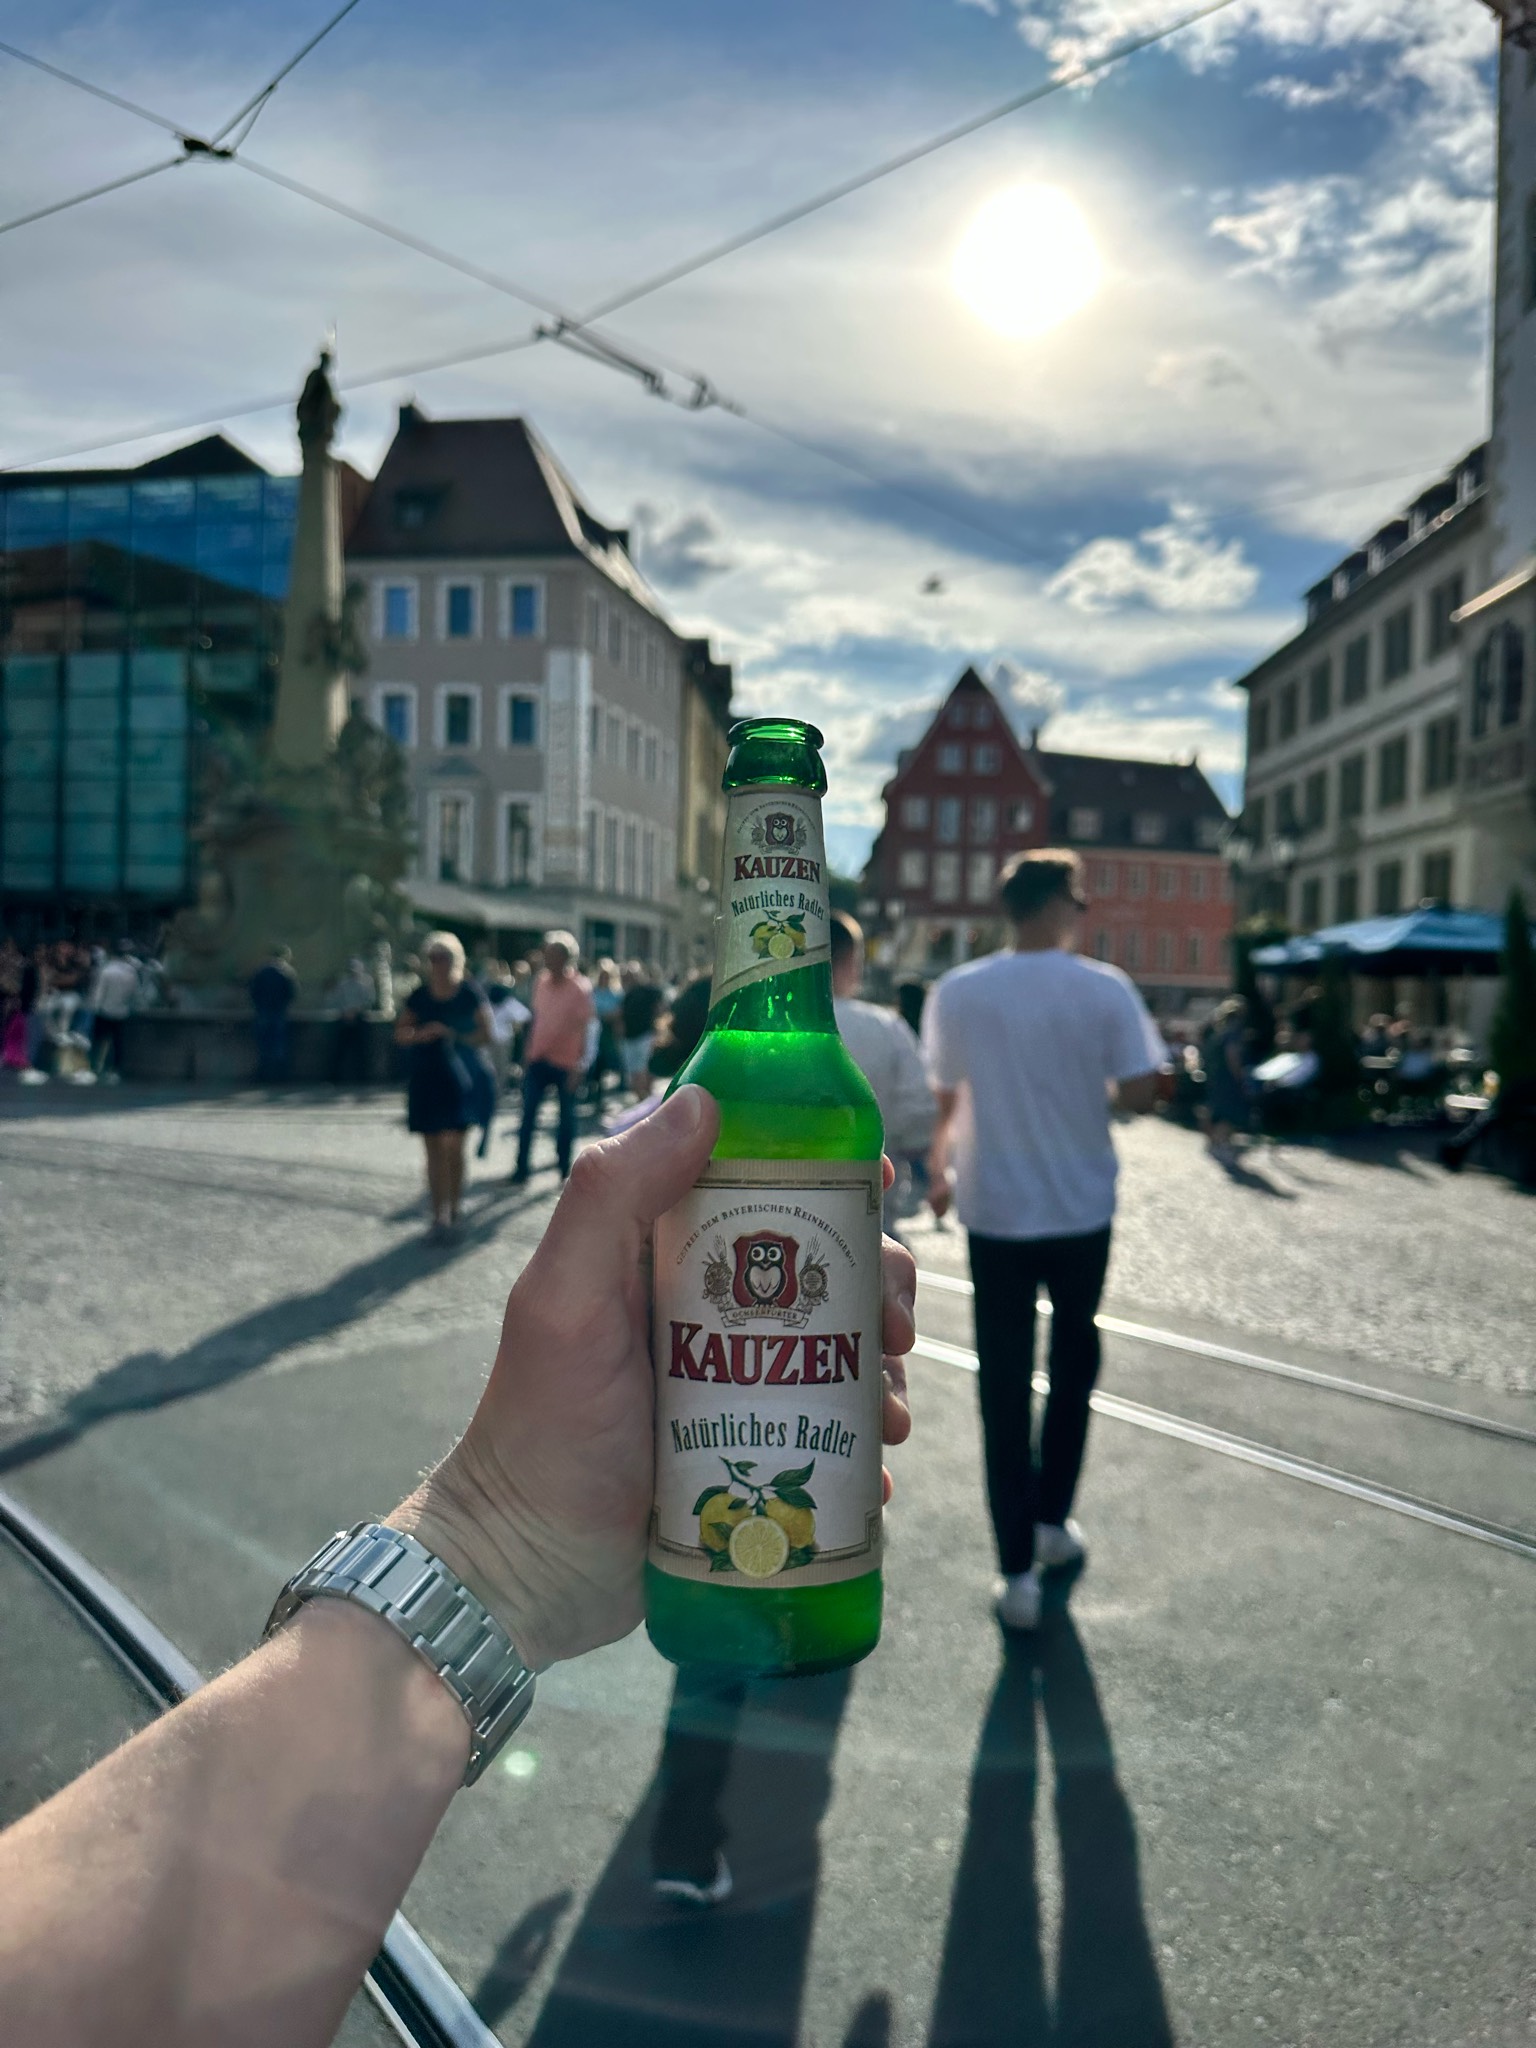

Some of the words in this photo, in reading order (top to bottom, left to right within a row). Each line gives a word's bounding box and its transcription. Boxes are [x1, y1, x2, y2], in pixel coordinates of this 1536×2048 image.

[734, 854, 820, 884] KAUZEN
[731, 890, 794, 917] Natürliches
[798, 892, 824, 921] Radler
[701, 1215, 719, 1232] DEM
[721, 1203, 792, 1220] BAYERISCHEN
[793, 1206, 857, 1268] REINHEITSGEBOT
[669, 1320, 861, 1385] KAUZEN
[671, 1412, 787, 1453] Natürliches
[795, 1414, 857, 1458] Radler
